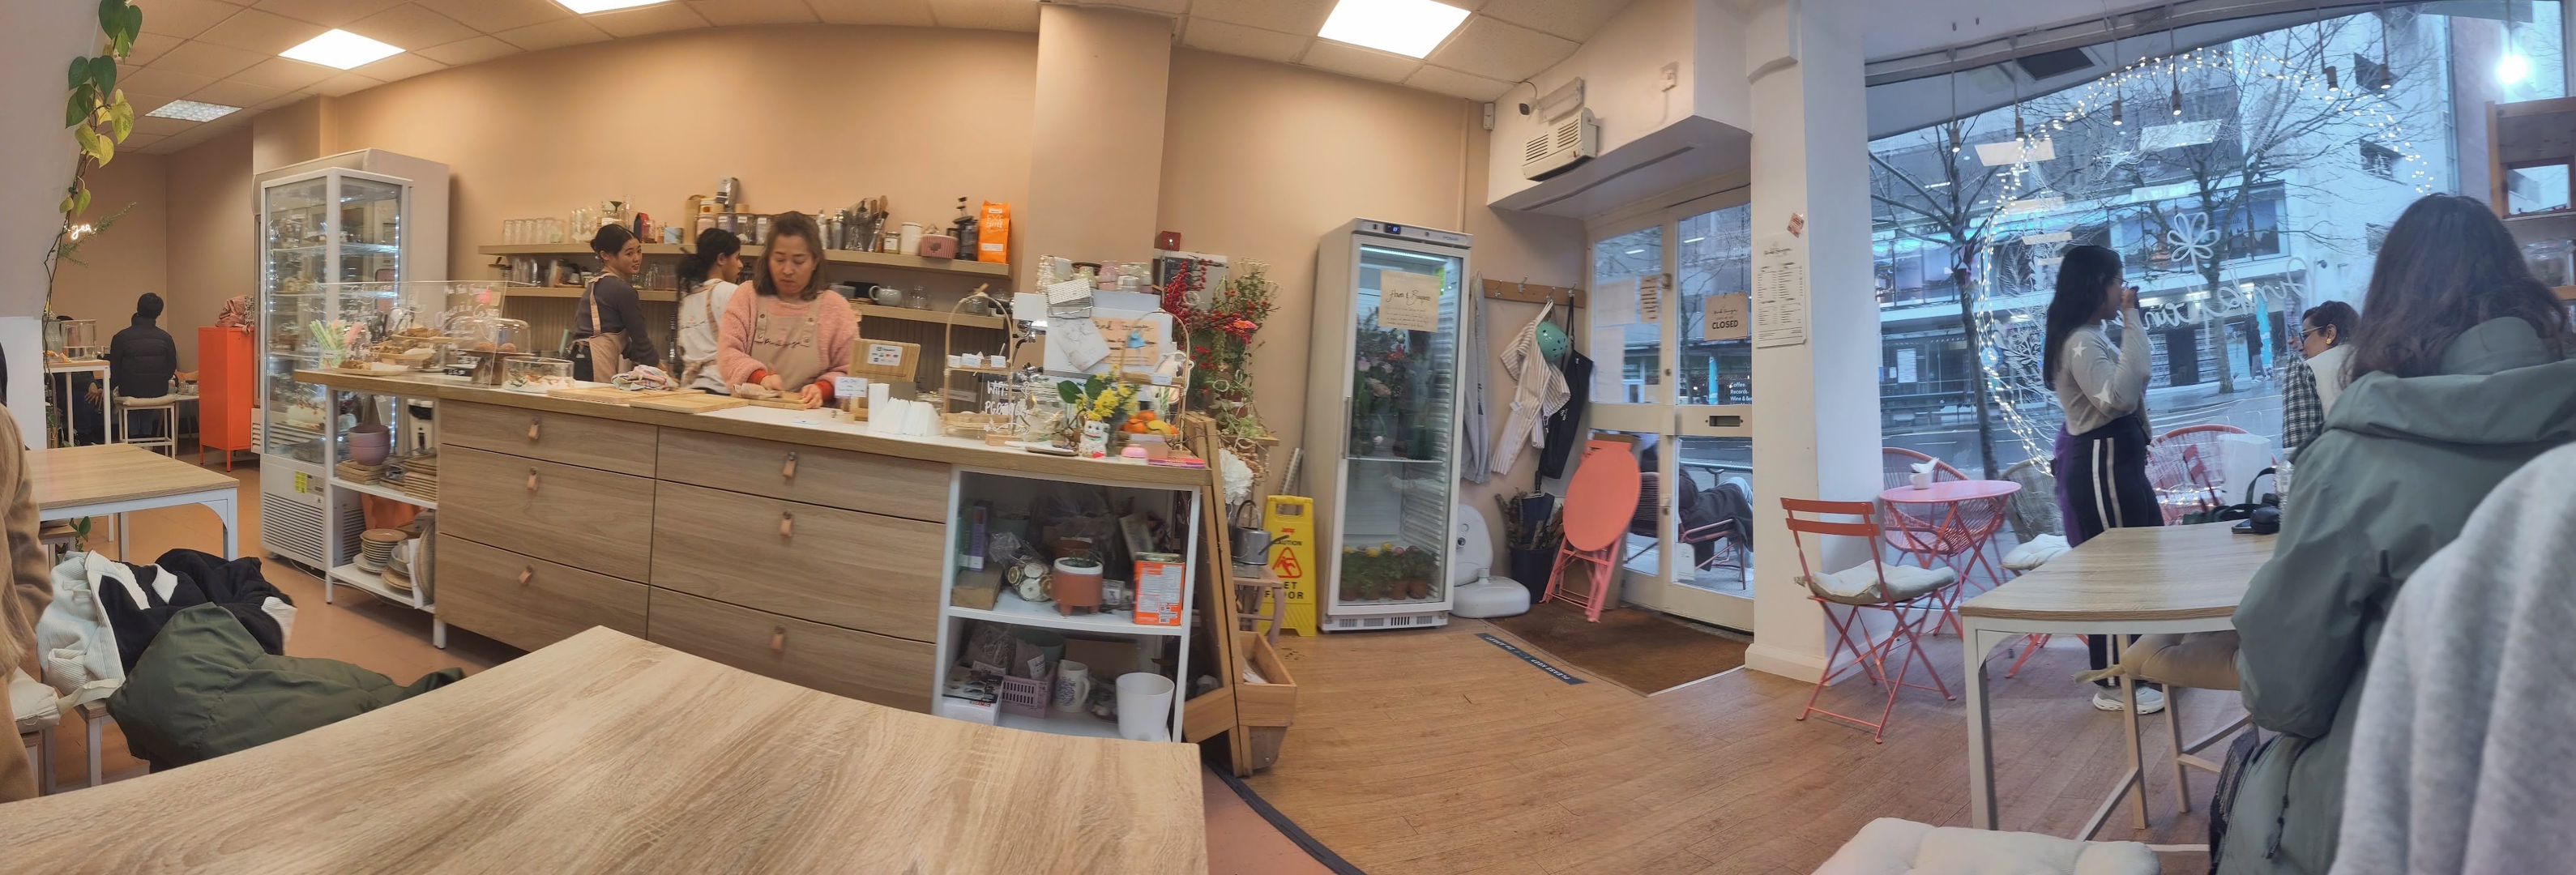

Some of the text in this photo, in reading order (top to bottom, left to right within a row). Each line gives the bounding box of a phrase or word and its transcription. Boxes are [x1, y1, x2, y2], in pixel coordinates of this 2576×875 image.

[1711, 320, 1739, 330] CLOSED
[1530, 659, 1547, 669] KEEP
[1547, 667, 1570, 680] PLEASE
